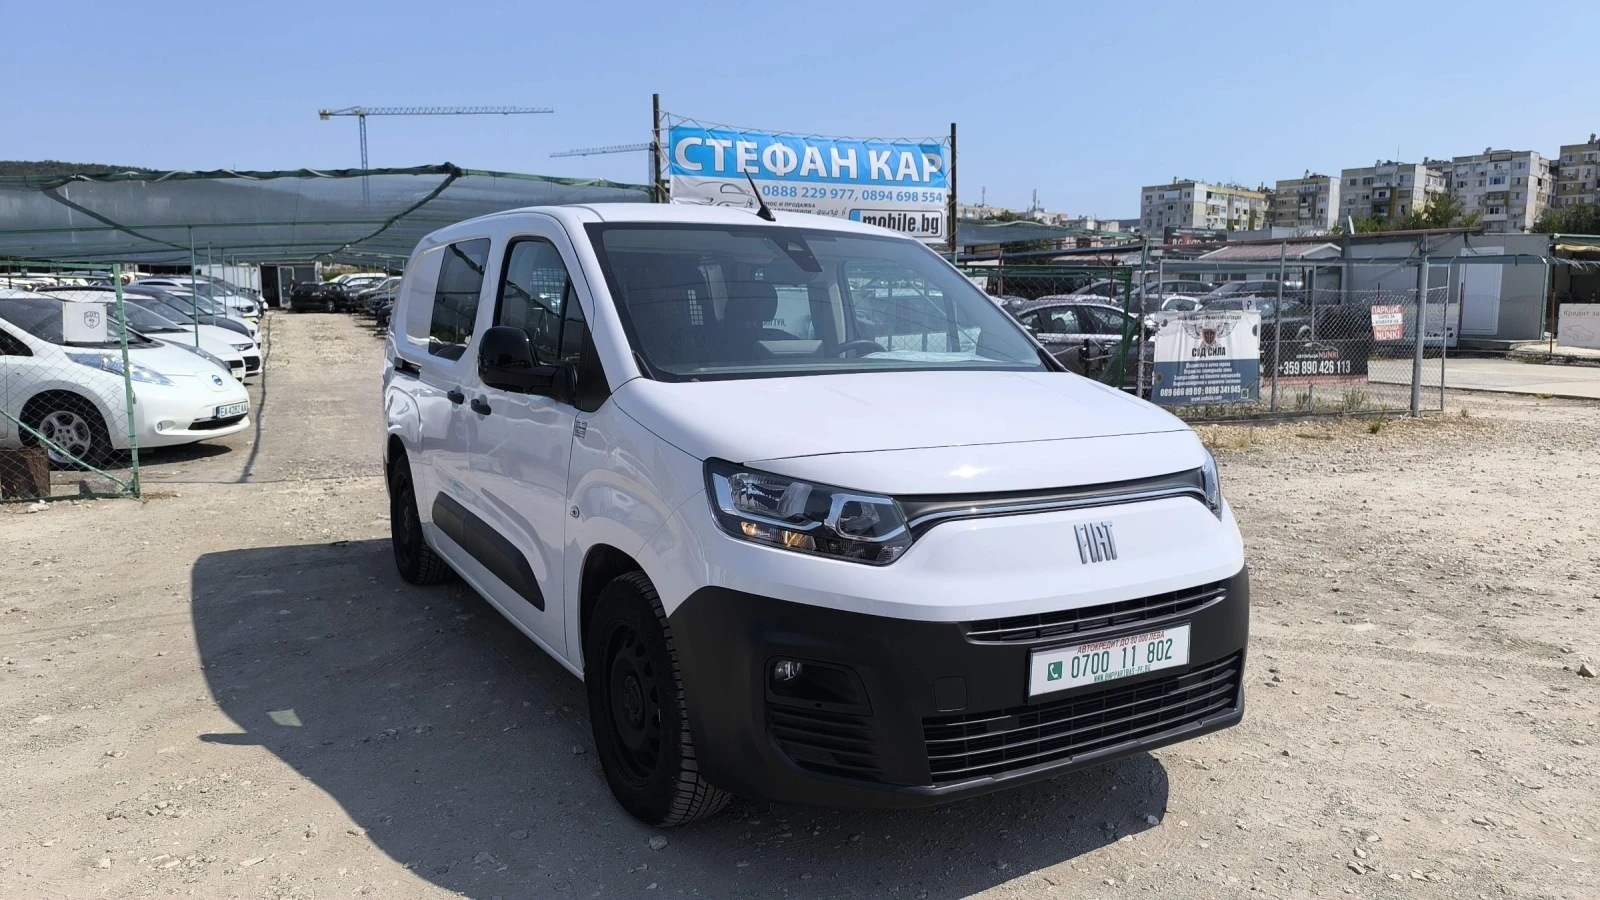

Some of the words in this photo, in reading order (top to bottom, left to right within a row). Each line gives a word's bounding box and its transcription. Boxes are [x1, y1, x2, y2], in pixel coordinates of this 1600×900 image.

[675, 136, 858, 179] СТЕФАН
[868, 149, 942, 183] КАР
[762, 185, 797, 198] 0888
[801, 187, 827, 199] 229
[861, 189, 893, 201] 0894
[896, 191, 919, 202] 698
[921, 192, 943, 203] 554
[862, 212, 940, 235] mobile.bg
[1371, 304, 1402, 314] ПАРКИНГ
[1376, 330, 1400, 340] NUNKI
[1207, 347, 1226, 357] СИЛА
[1318, 351, 1339, 359] NUNKI
[1278, 361, 1300, 375] +359
[1301, 360, 1318, 375] 890
[1318, 360, 1334, 374] 426
[1336, 360, 1351, 374] 113
[1160, 388, 1172, 397] 089
[1220, 385, 1230, 394] 341
[1074, 521, 1118, 565] FIAT
[1077, 640, 1119, 654] АВТОКРЕДИТ
[1119, 637, 1130, 647] ДО
[1148, 630, 1165, 641] ЛЕВА
[1071, 650, 1110, 679] 0700
[1122, 644, 1136, 669] 11
[1147, 638, 1173, 664] 802
